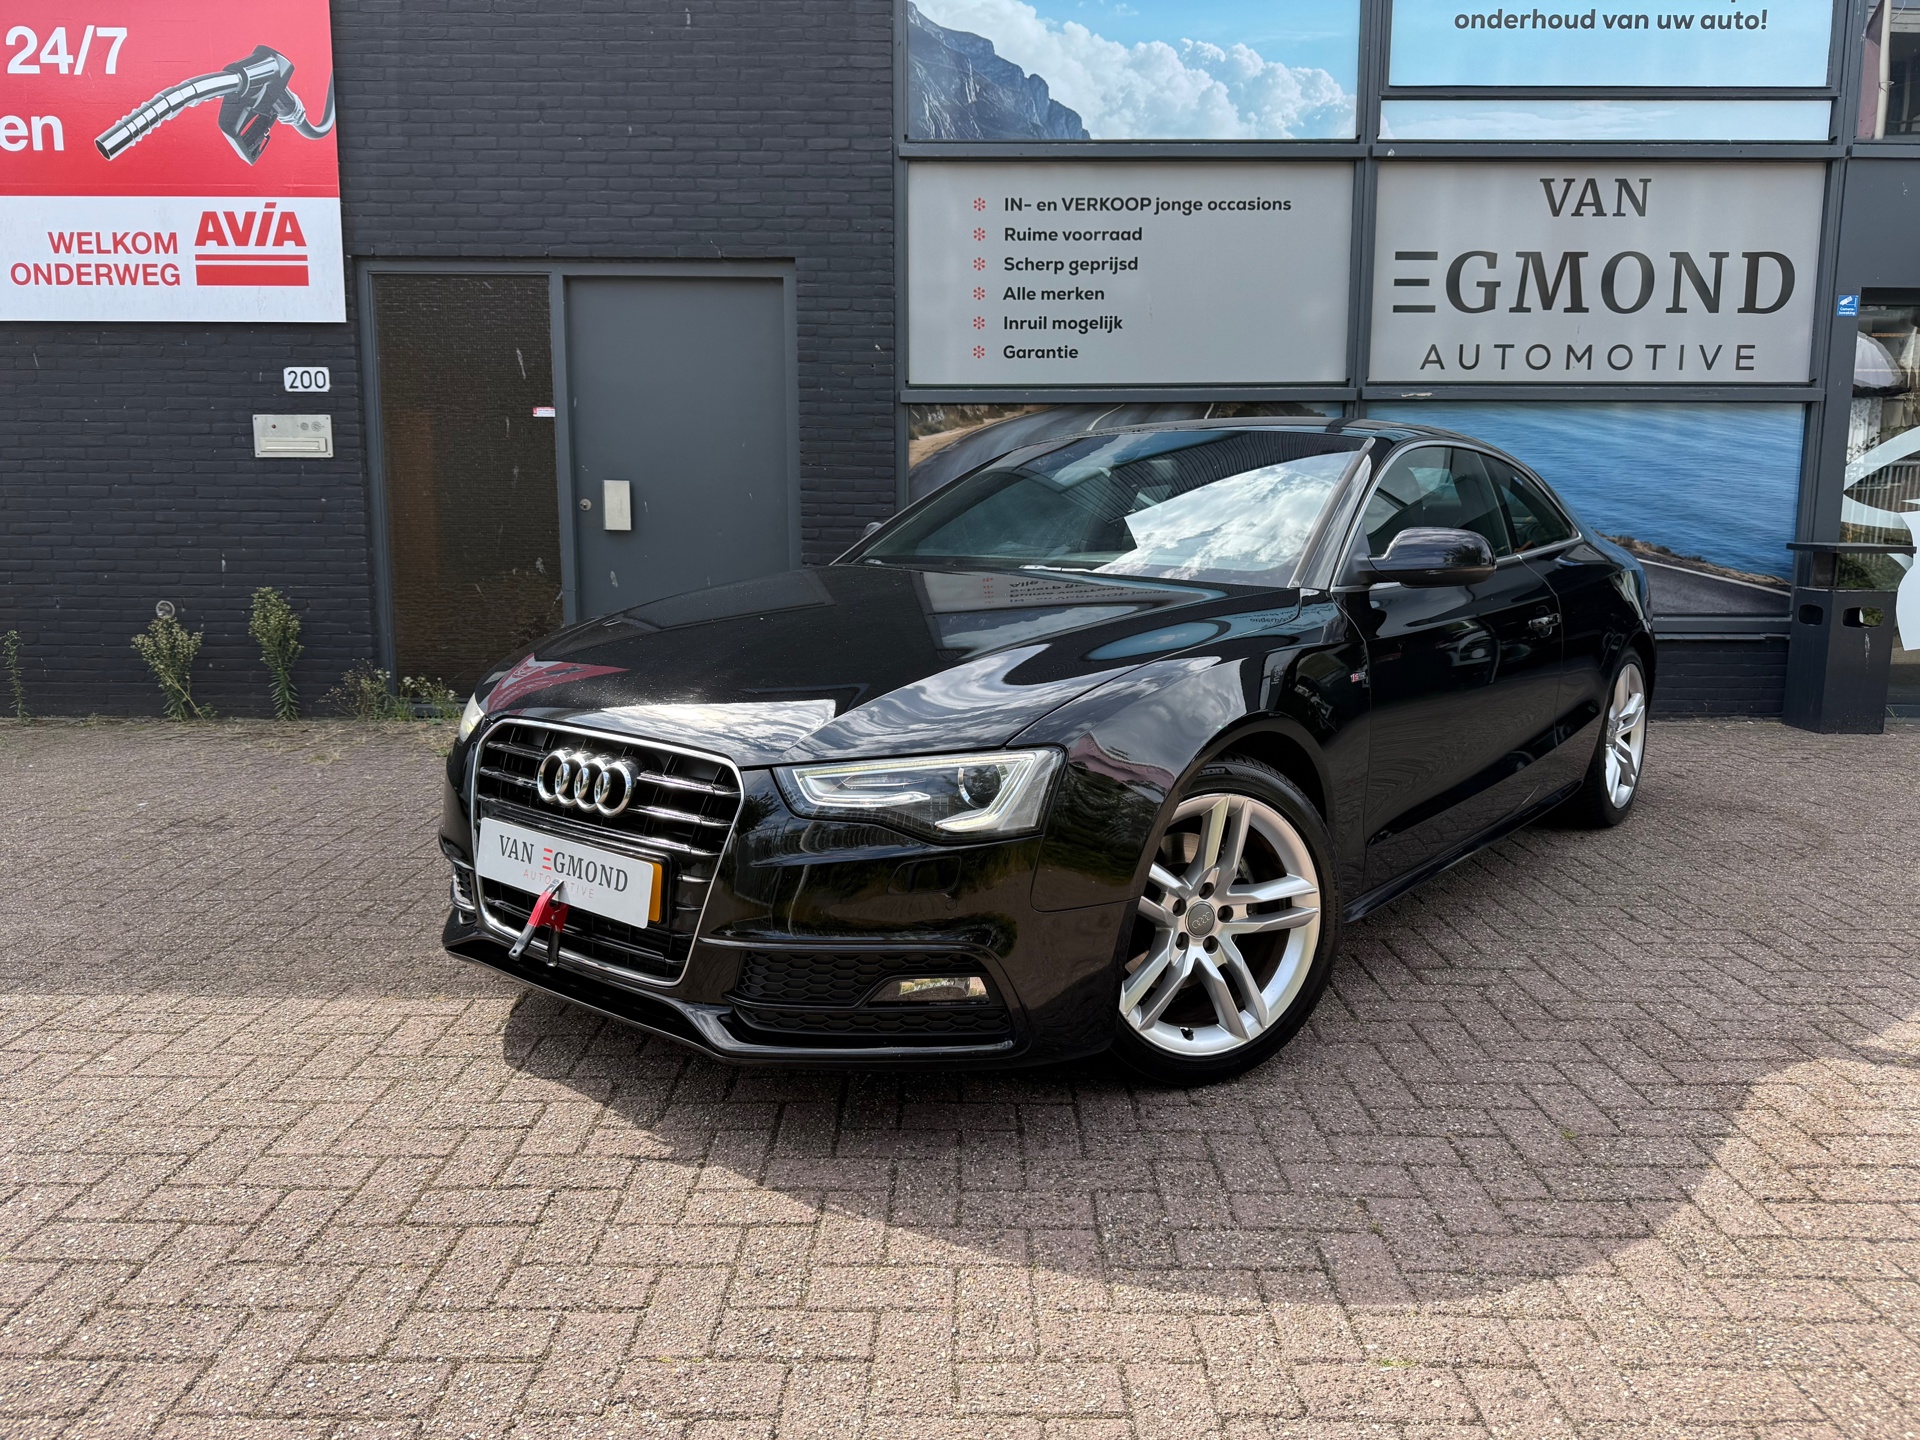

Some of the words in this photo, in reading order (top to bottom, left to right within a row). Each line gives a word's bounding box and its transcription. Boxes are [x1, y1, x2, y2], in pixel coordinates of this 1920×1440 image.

[1454, 9, 1596, 29] onderhoud
[1602, 14, 1649, 29] van
[1657, 14, 1695, 29] uw
[1700, 10, 1768, 29] auto!
[5, 24, 128, 75] 24/7
[1004, 198, 1032, 211] IN-
[1036, 201, 1058, 211] en
[1061, 197, 1152, 211] VERKOOP
[1153, 197, 1203, 215] jonge
[1207, 197, 1292, 211] occasions
[1539, 178, 1652, 217] VAN
[194, 202, 307, 247] AVIA
[1004, 227, 1058, 241] Ruime
[1062, 227, 1143, 241] voorraad
[48, 232, 178, 254] WELKOM
[10, 262, 181, 286] ONDERWEG
[1003, 257, 1064, 274] Scherp
[1068, 257, 1138, 275] geprijsd
[1003, 286, 1036, 300] Alle
[1040, 287, 1105, 301] merken
[1389, 251, 1796, 314] EGMOND
[1003, 316, 1048, 330] Inruil
[1052, 316, 1123, 334] mogelijk
[1003, 344, 1079, 359] Garantie
[1419, 344, 1756, 371] AUTOMOTIVE
[287, 370, 327, 390] 200
[499, 835, 535, 864] VAN
[542, 847, 628, 893] EGMOND
[522, 869, 594, 899] AUTOOTIVE
